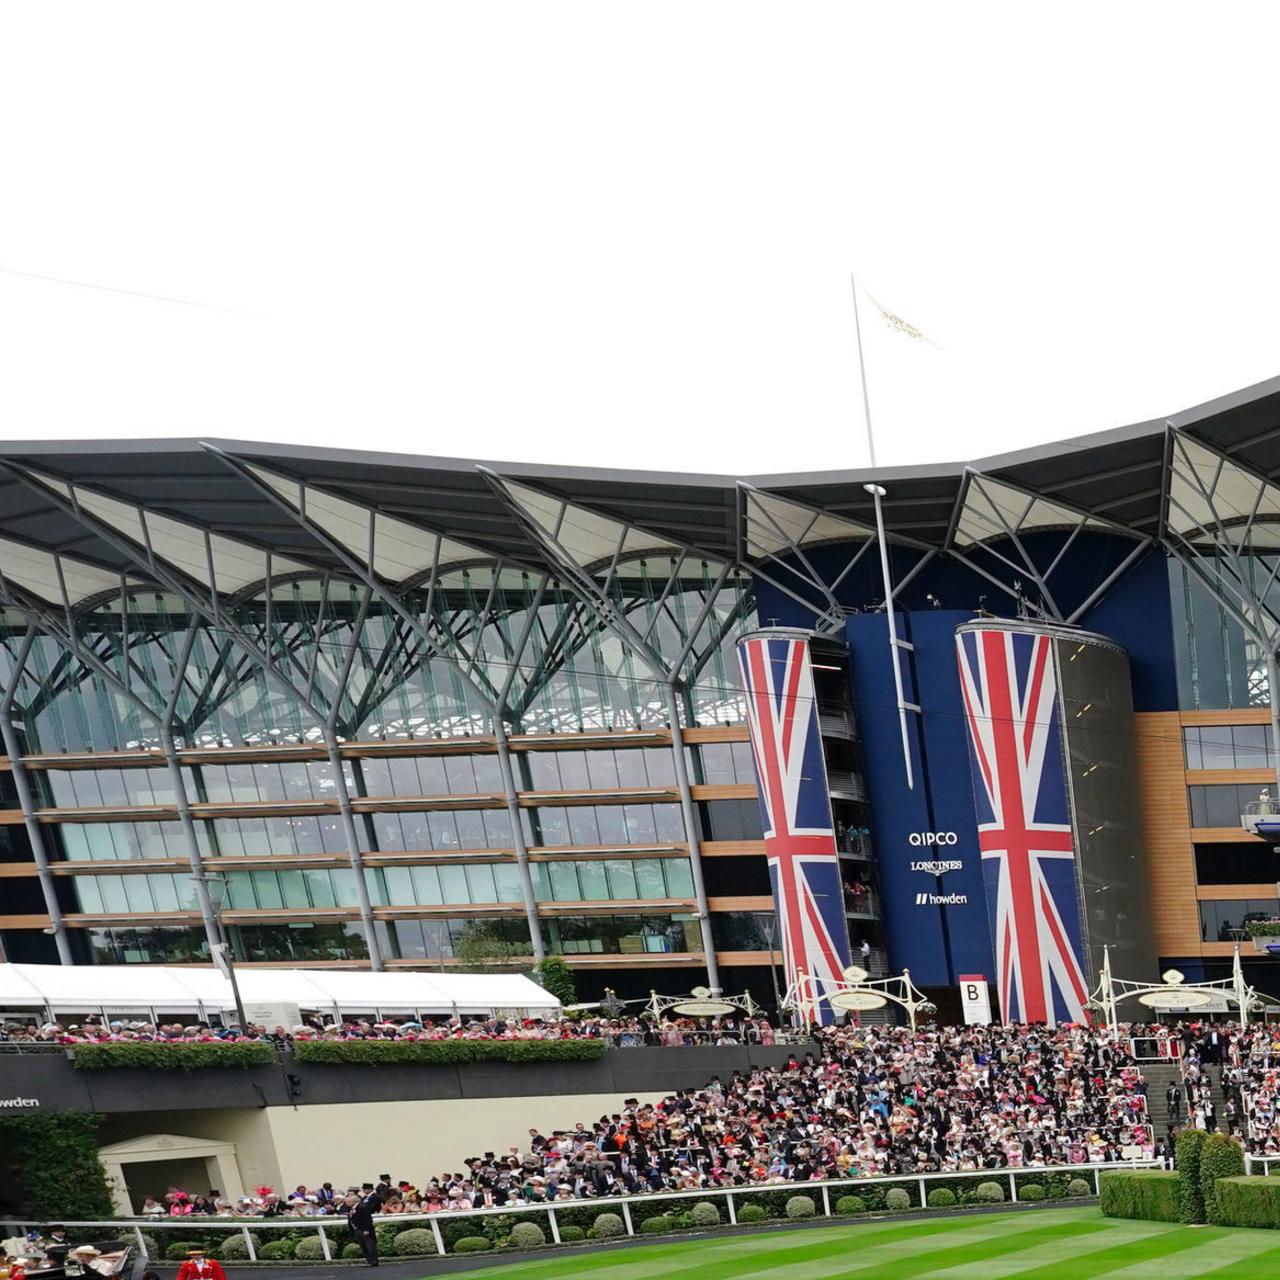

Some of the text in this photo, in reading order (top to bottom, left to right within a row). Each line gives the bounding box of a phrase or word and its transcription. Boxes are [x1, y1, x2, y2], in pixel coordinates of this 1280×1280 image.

[909, 832, 958, 846] QIPCO
[911, 860, 963, 871] LONGINES
[929, 893, 968, 905] howden
[967, 984, 979, 1001] B
[0, 1096, 40, 1108] wden
